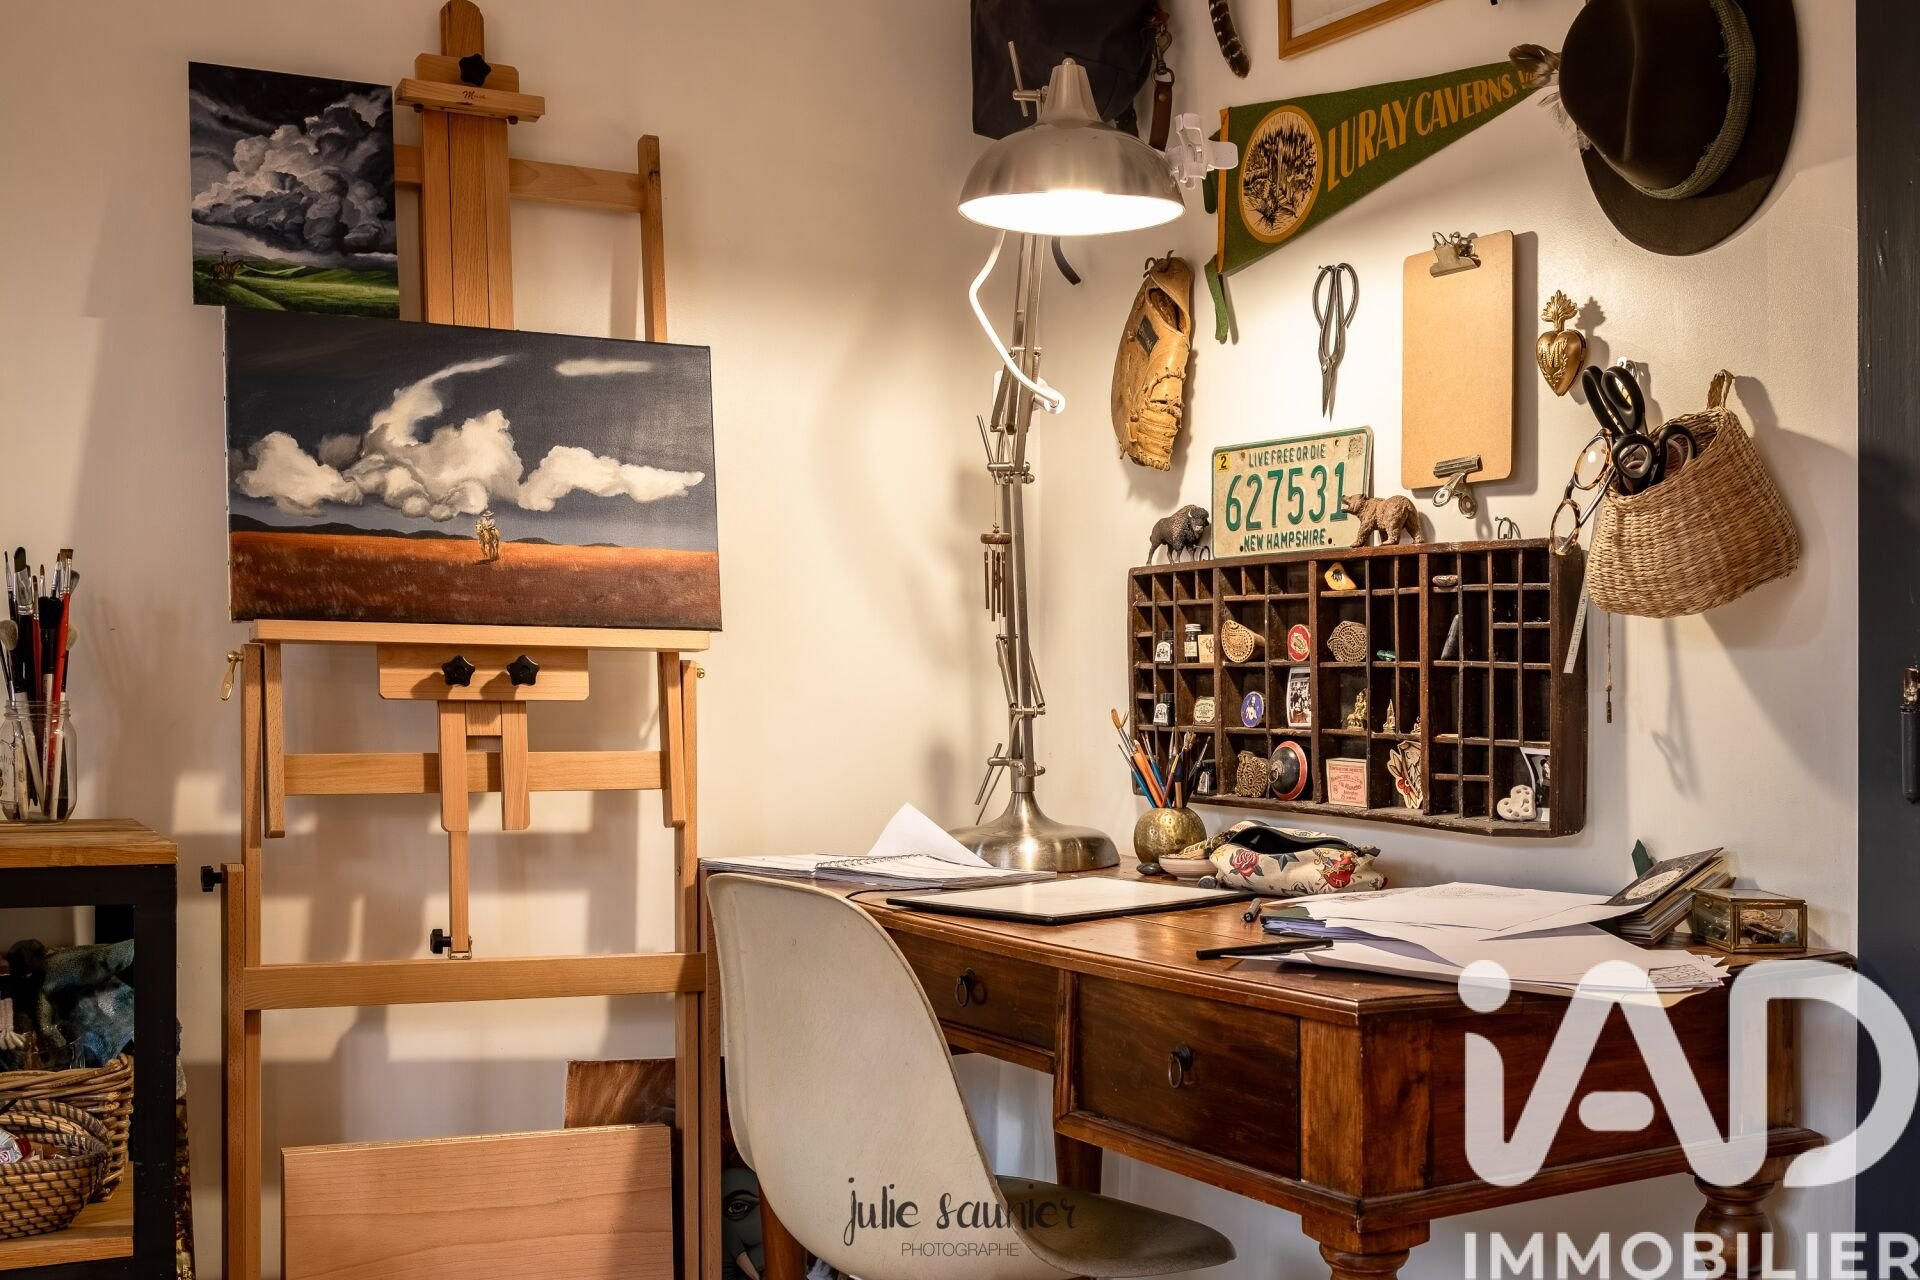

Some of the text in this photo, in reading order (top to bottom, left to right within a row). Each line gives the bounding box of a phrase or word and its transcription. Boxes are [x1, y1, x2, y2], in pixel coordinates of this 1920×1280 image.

[1327, 96, 1412, 193] LURAY
[1220, 455, 1227, 469] 2
[1248, 443, 1326, 468] LIVE FREE OR DIE
[1225, 461, 1348, 532] 627531
[1243, 528, 1326, 552] NEW HAMPSHIRE
